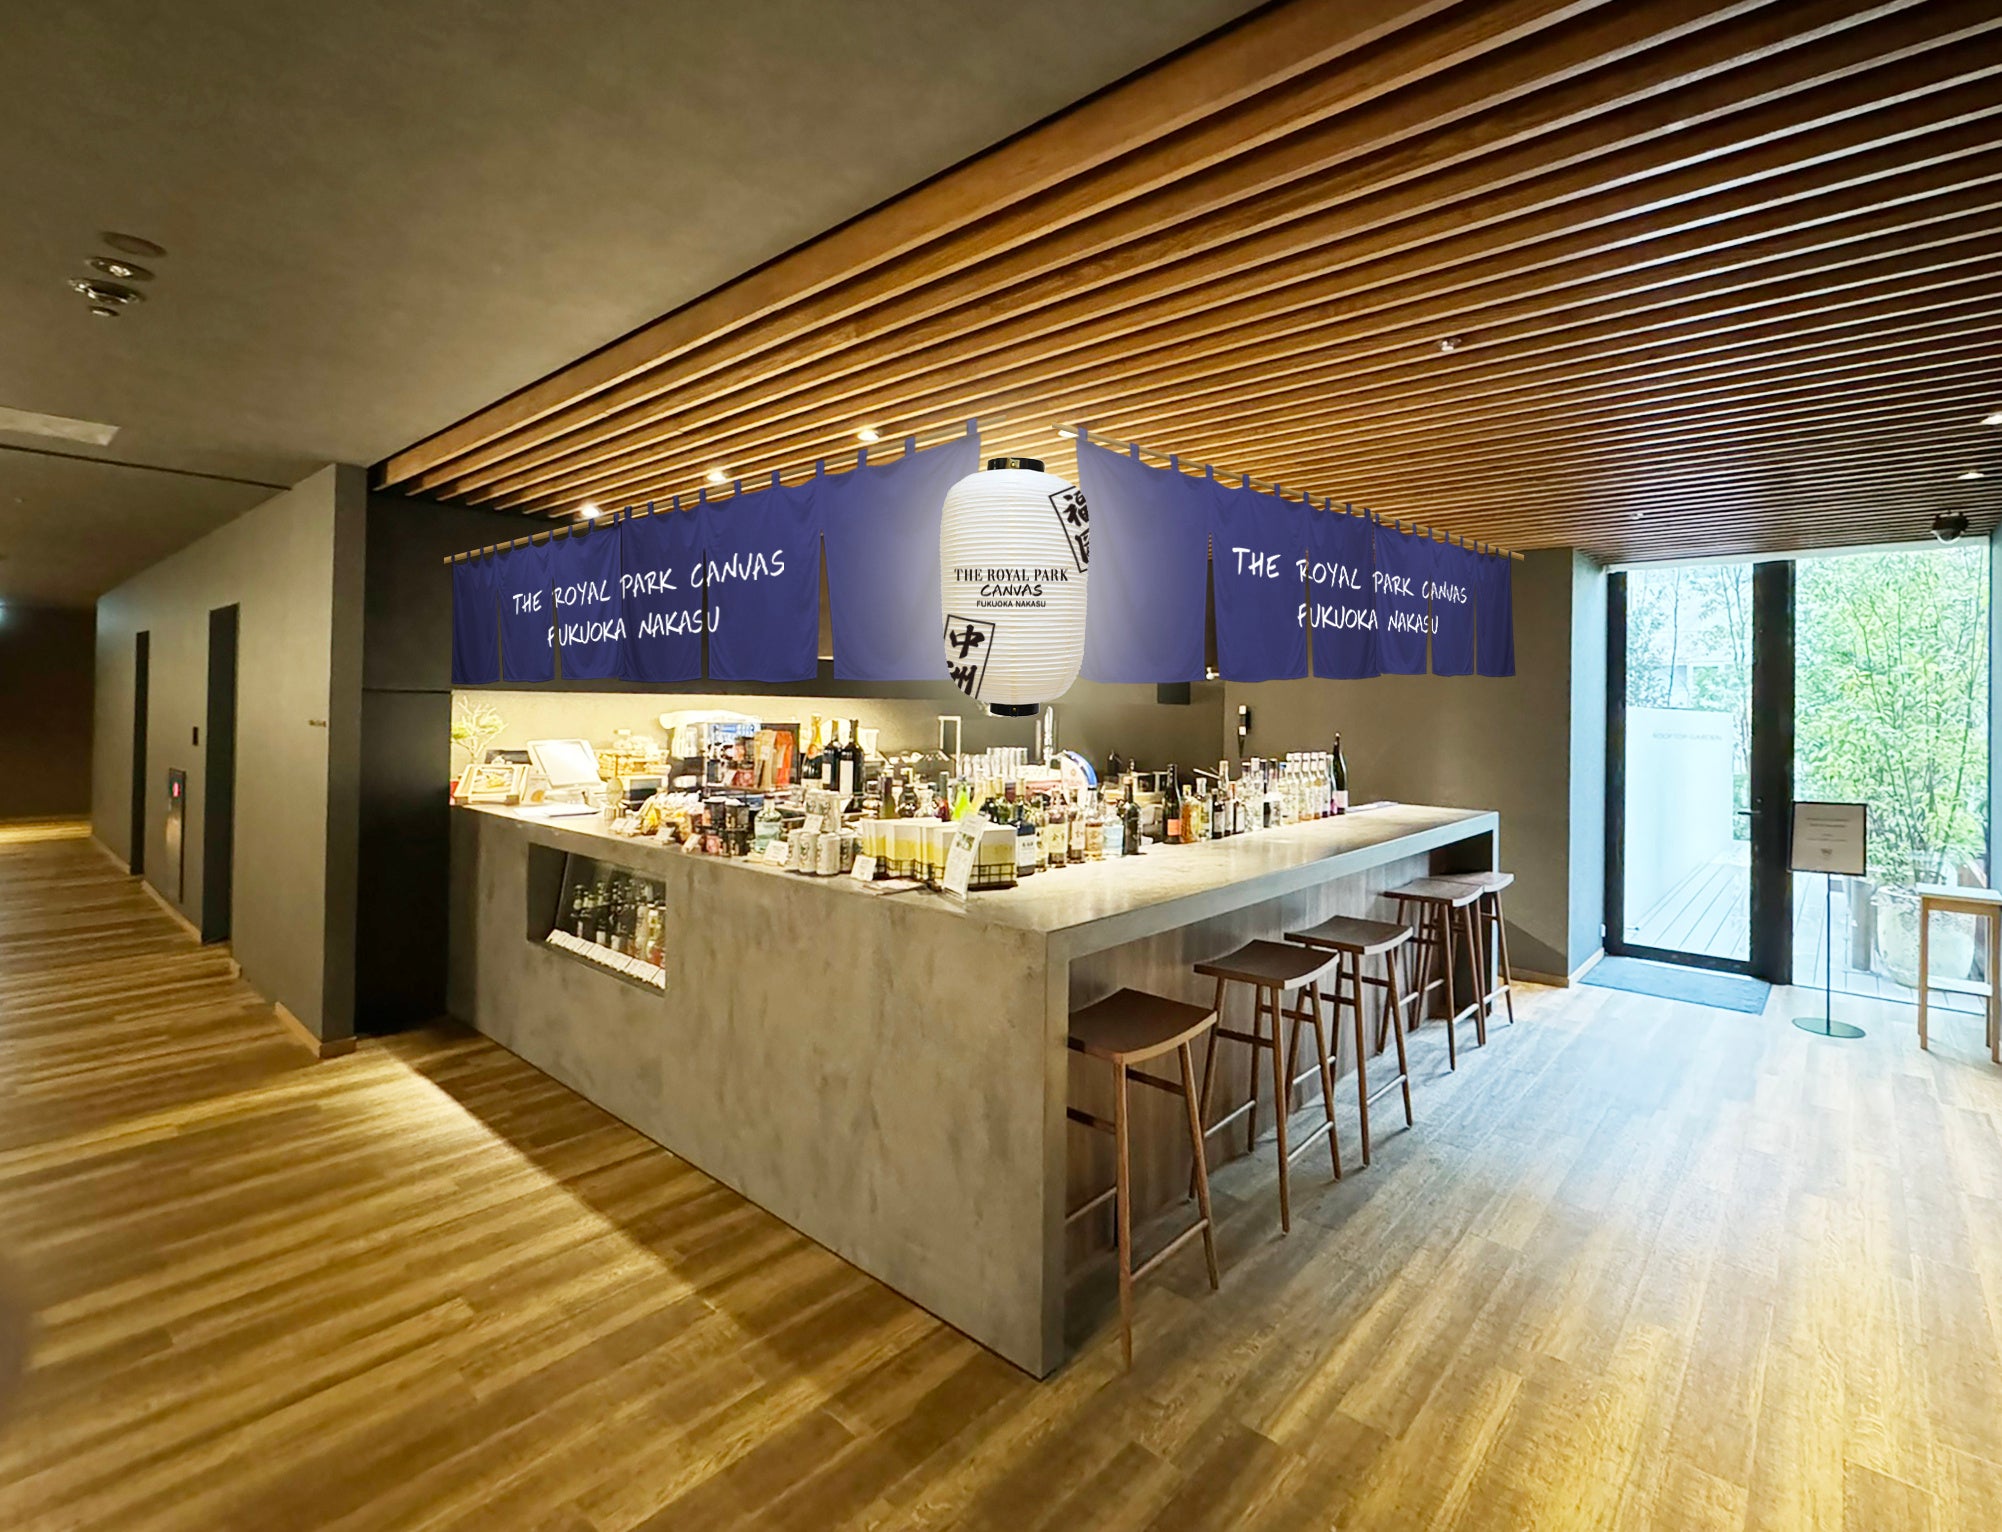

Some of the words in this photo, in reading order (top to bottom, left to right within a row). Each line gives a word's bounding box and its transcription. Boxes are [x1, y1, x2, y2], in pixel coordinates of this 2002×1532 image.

[512, 590, 543, 615] THE
[552, 579, 611, 608] ROYAL
[620, 568, 677, 599] PARK
[690, 549, 785, 588] CANVAS
[954, 568, 983, 581] THE
[987, 568, 1030, 581] ROYAL
[1034, 568, 1069, 581] PARK
[980, 584, 1043, 597] CANVAS
[1232, 547, 1282, 579] THE
[1296, 558, 1362, 590] ROYAL
[1372, 570, 1415, 597] PARK
[1421, 580, 1468, 604] CANVAS
[976, 600, 1013, 608] FUKUOKA
[1015, 600, 1046, 608] NAKASU
[1297, 603, 1379, 631] FUKUOKA
[1387, 609, 1440, 635] NAKASU
[547, 617, 627, 648] FUKUOKA
[638, 605, 720, 639] NAKASU
